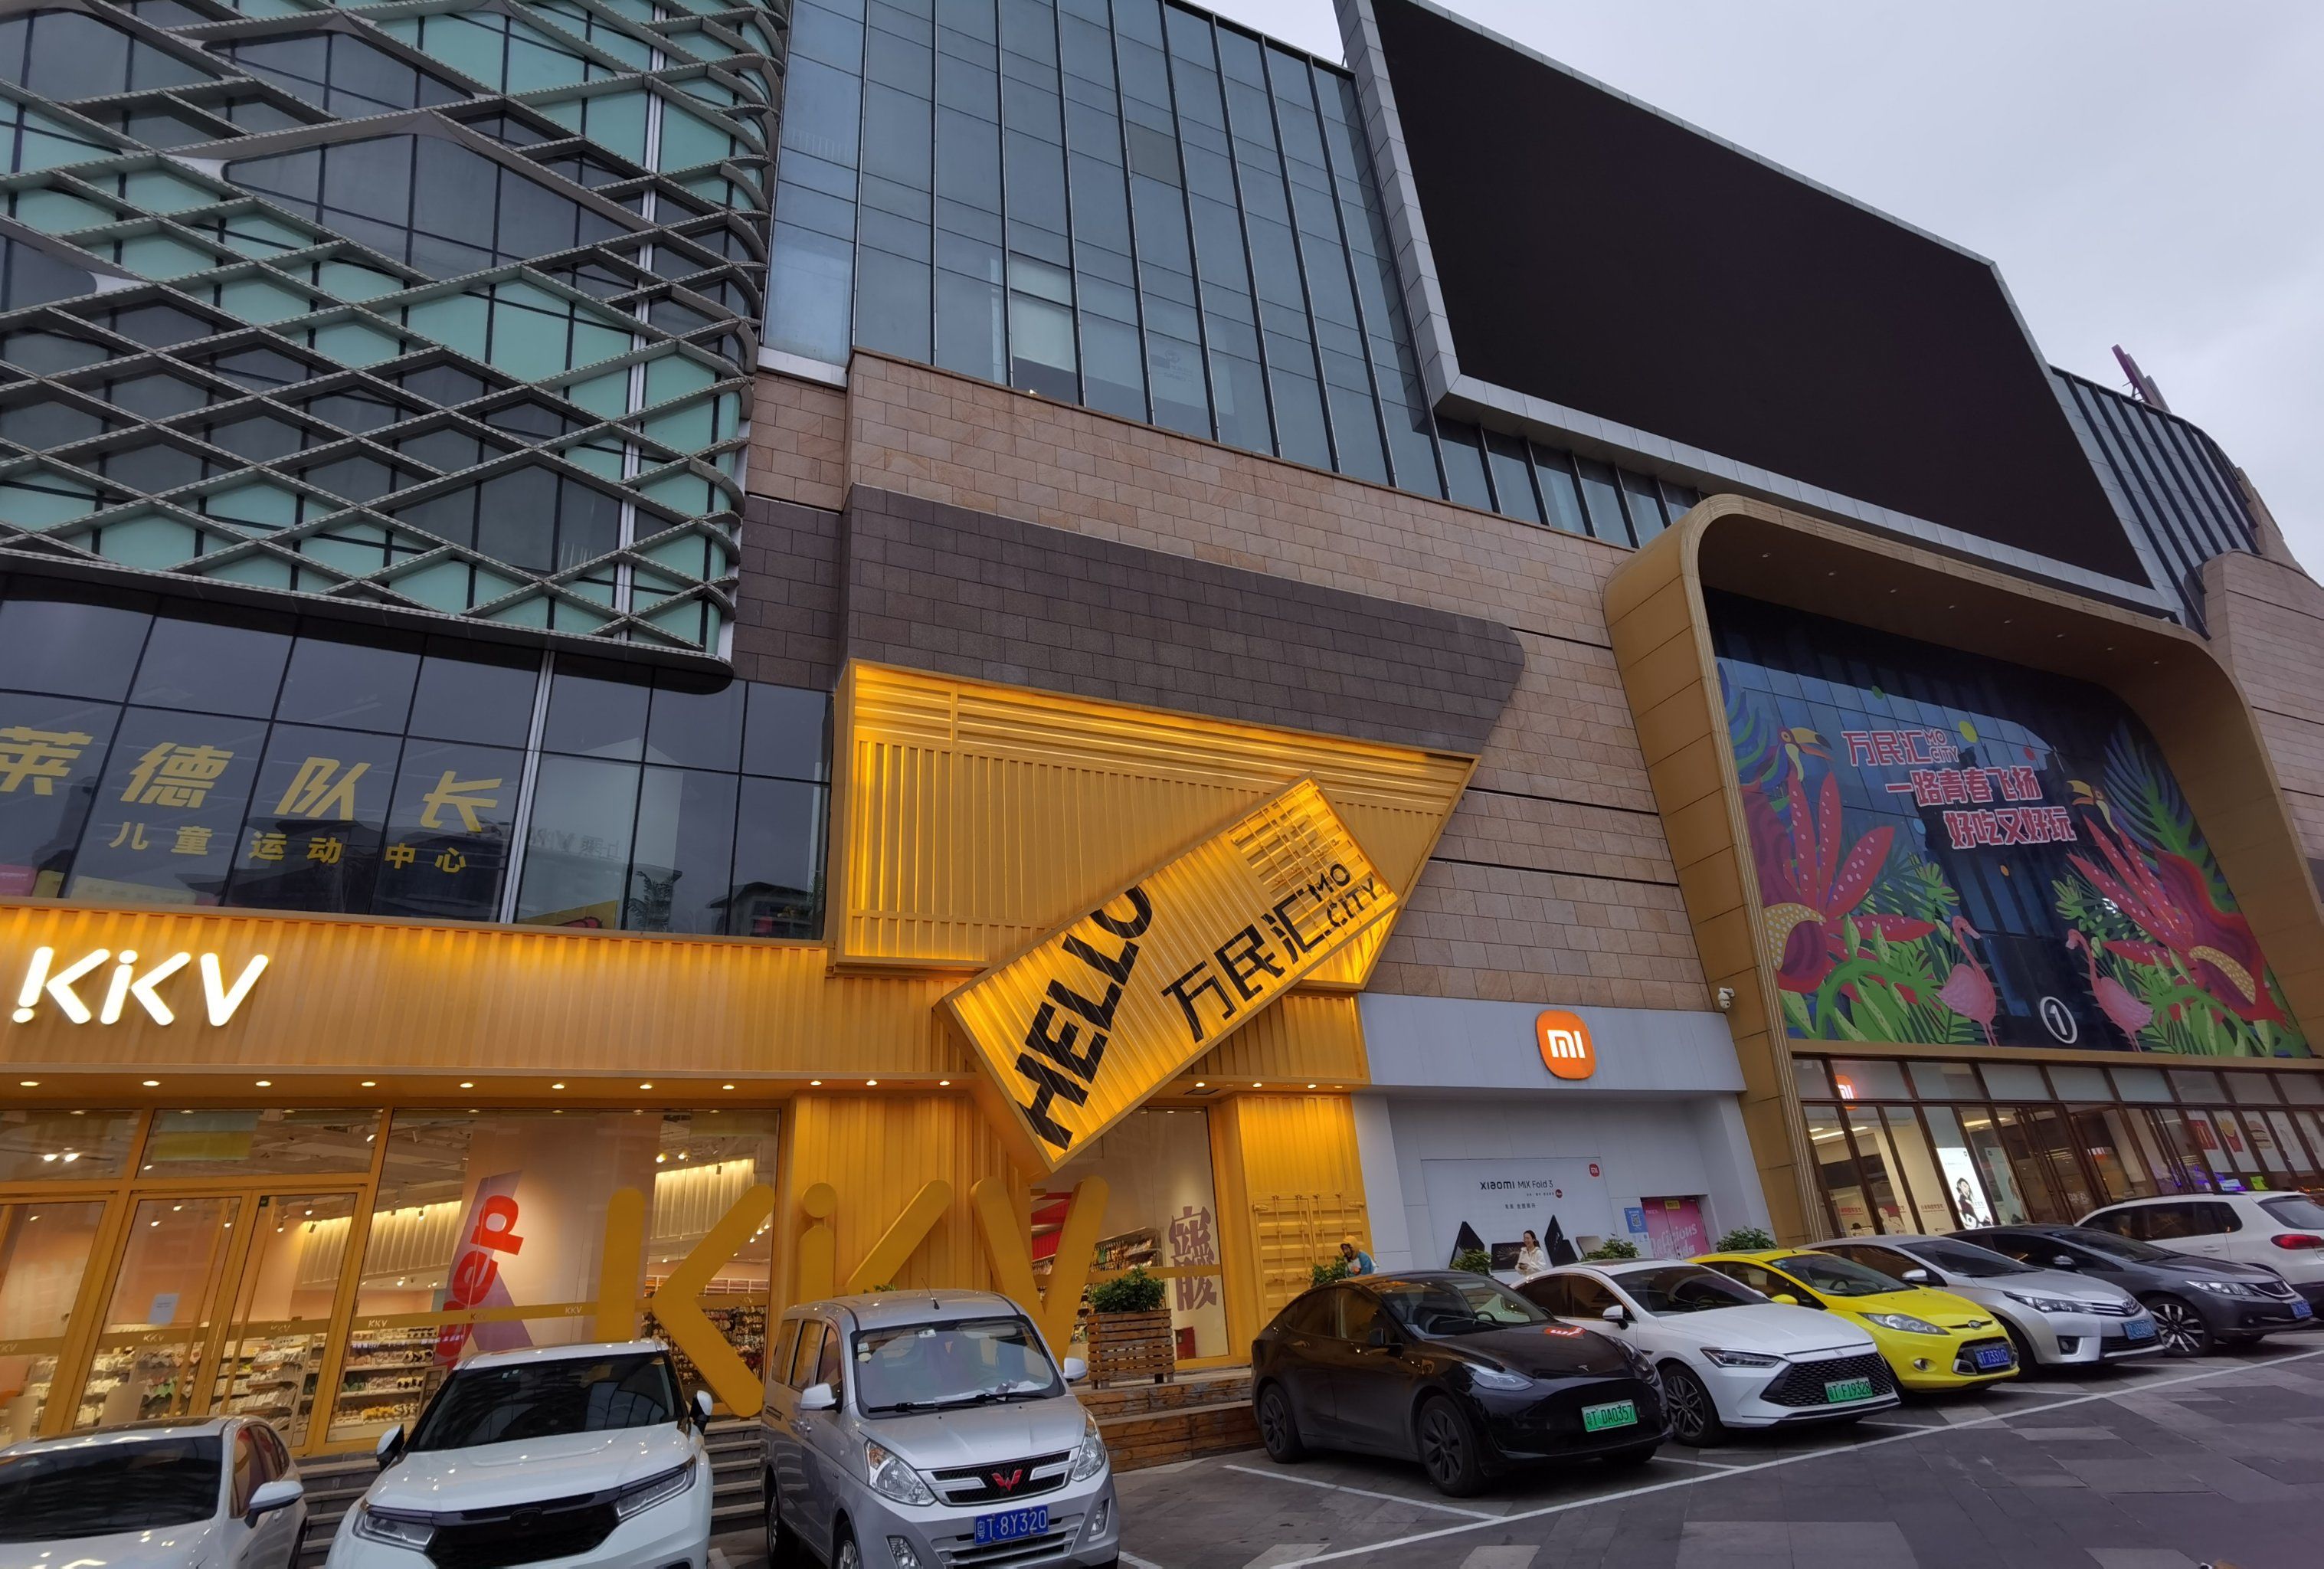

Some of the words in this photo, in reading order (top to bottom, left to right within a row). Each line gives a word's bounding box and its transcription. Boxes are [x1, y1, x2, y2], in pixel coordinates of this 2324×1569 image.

[1841, 729, 1933, 767] 万民汇
[1923, 729, 1948, 745] MO
[1930, 745, 1959, 763] CITY
[1886, 766, 2043, 807] 一路青春飞扬
[109, 821, 467, 873] 儿童运动中心
[1943, 807, 2077, 850] 好吃又好玩
[1327, 877, 1379, 929] CITY
[1161, 889, 1332, 1043] 万民汇
[1307, 863, 1350, 902] MO
[1015, 885, 1154, 1151] HELLO
[1517, 1181, 1531, 1189] MIX
[1532, 1180, 1547, 1189] Fold
[1548, 1180, 1553, 1188] 3
[368, 1318, 388, 1328] KKV
